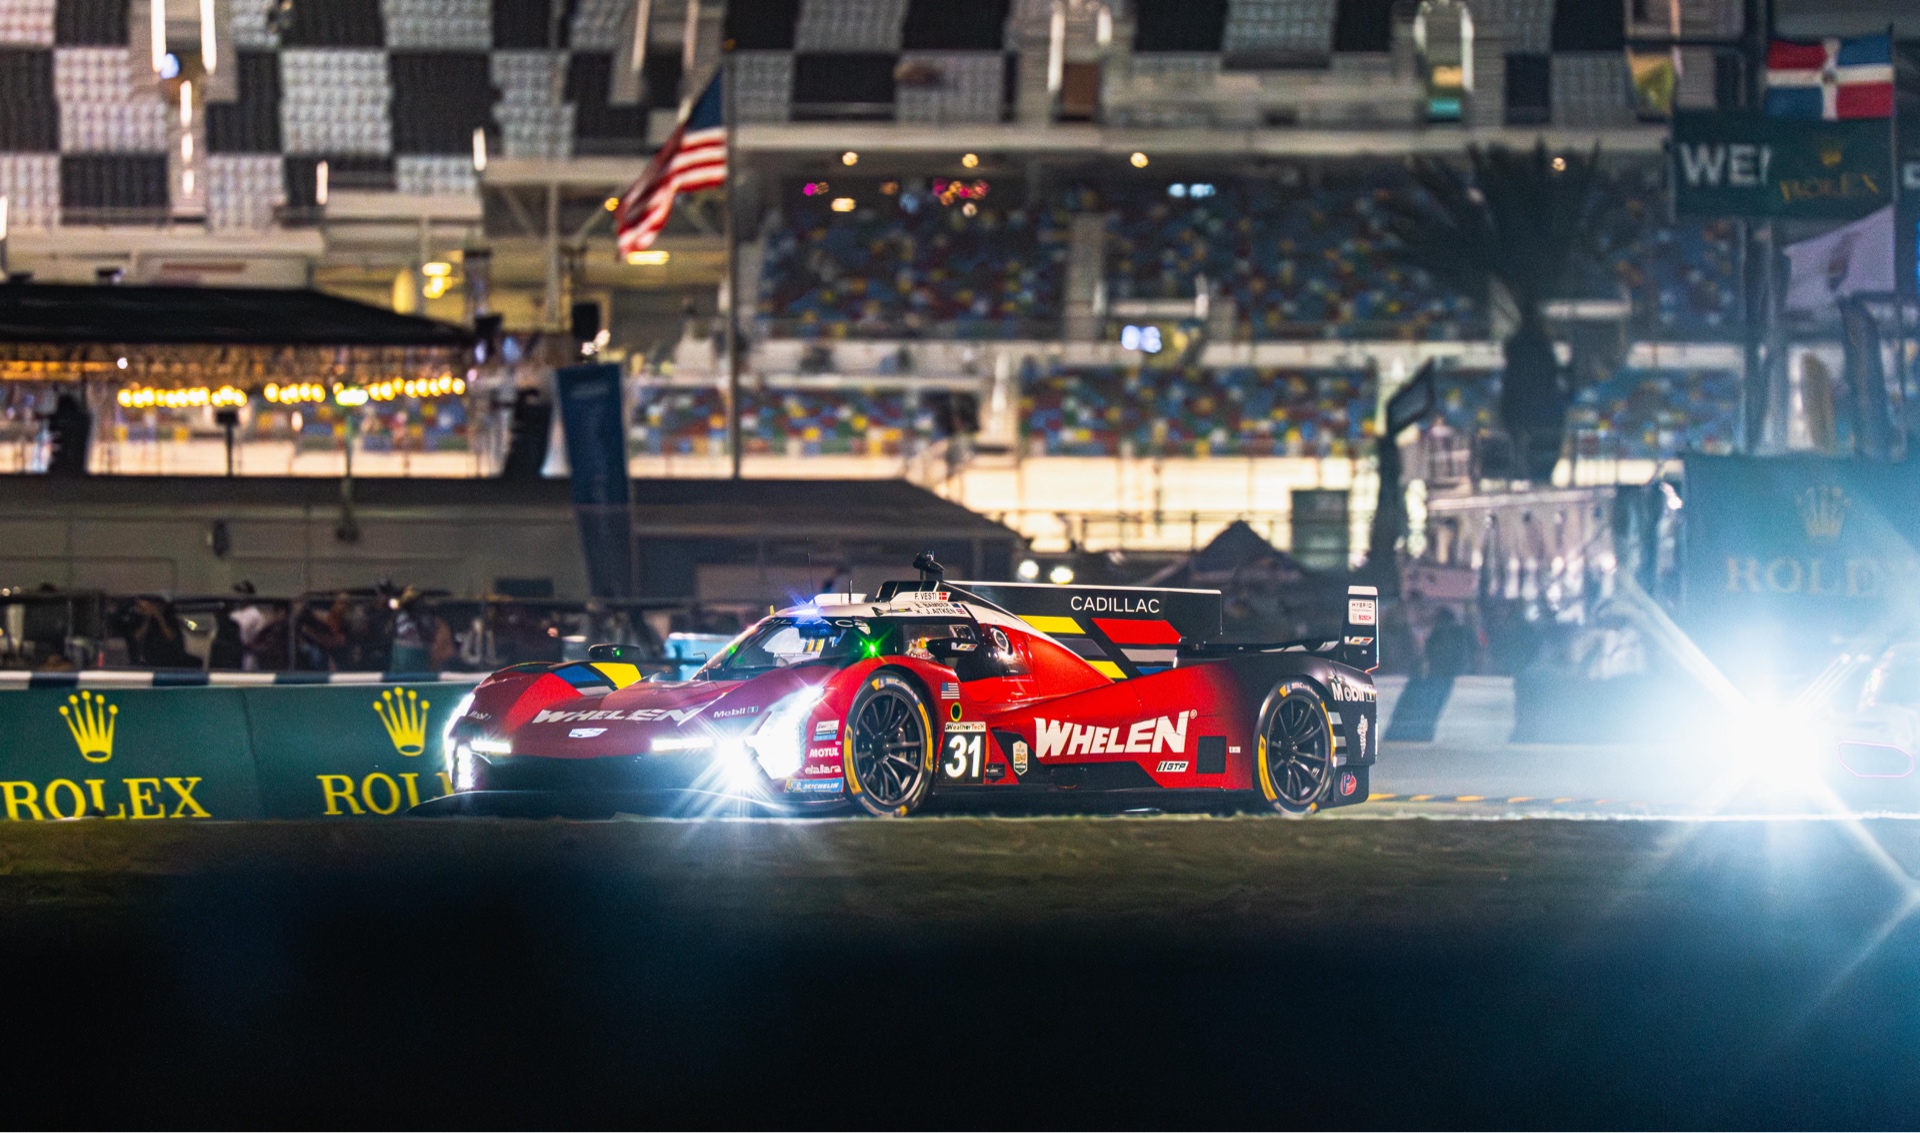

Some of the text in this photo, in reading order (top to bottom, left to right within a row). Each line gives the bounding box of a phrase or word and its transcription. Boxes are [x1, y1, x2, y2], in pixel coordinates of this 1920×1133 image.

[921, 592, 937, 600] VESTI
[1070, 595, 1161, 614] CADILLAC
[532, 708, 701, 727] WHELEN
[713, 707, 746, 719] Mobil
[1034, 710, 1190, 758] WHELEN
[809, 747, 839, 758] MOTUL
[945, 734, 982, 778] 31
[803, 782, 839, 790] MICHELIN
[0, 777, 212, 821] ROLEX
